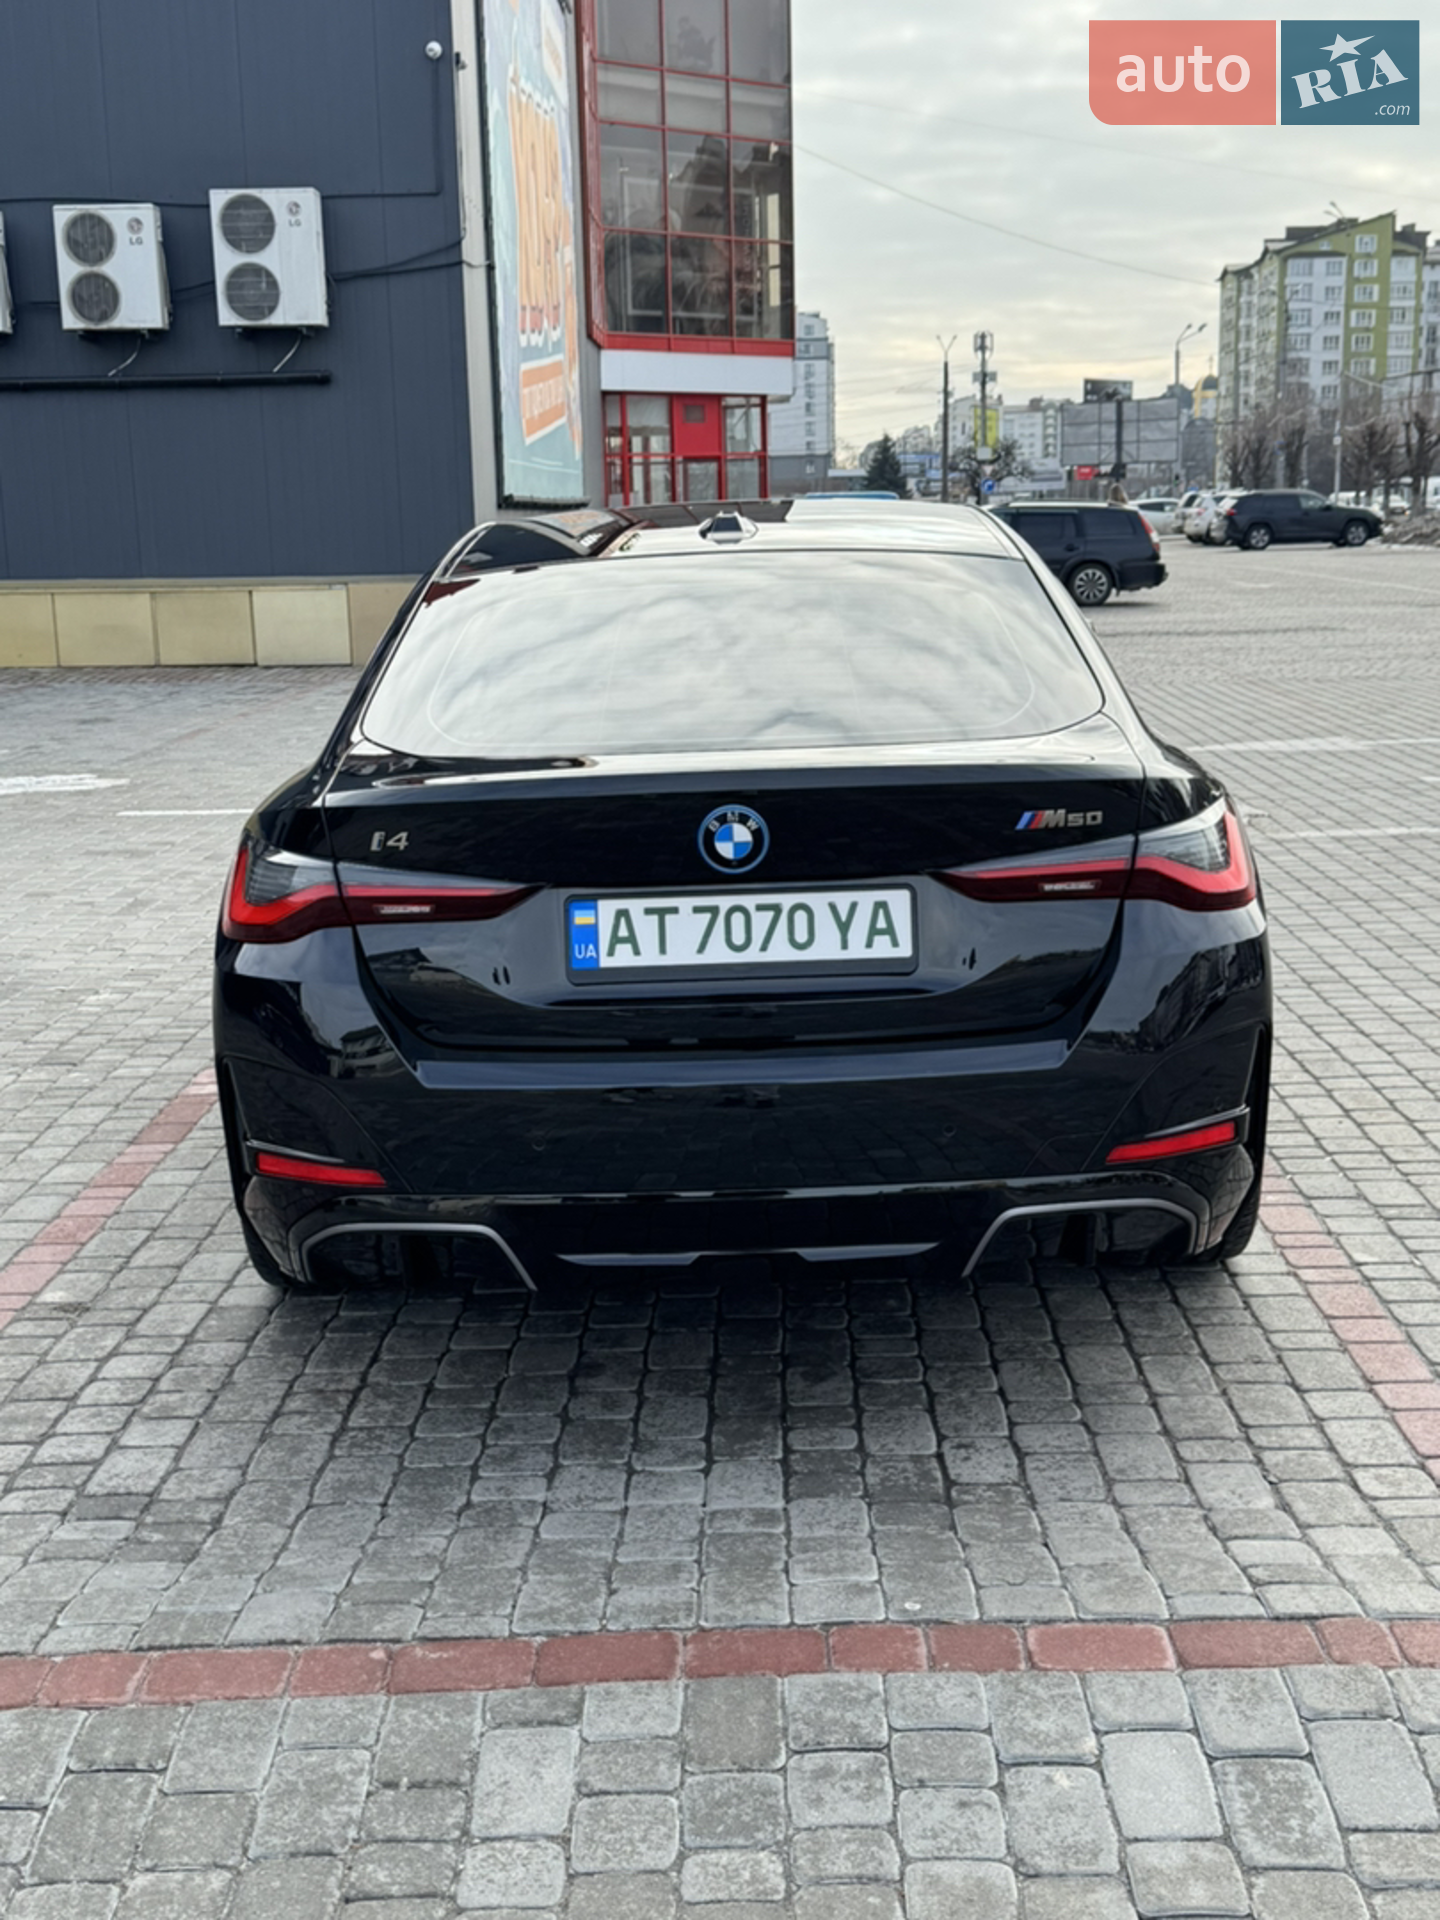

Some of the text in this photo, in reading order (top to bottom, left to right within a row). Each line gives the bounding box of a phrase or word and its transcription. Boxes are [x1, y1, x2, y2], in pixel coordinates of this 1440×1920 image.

[288, 218, 302, 227] LG
[129, 236, 143, 246] LG
[708, 811, 759, 832] BMW
[370, 831, 409, 851] i4
[692, 902, 815, 955] 7070
[828, 900, 900, 951] YA
[575, 943, 598, 959] UA
